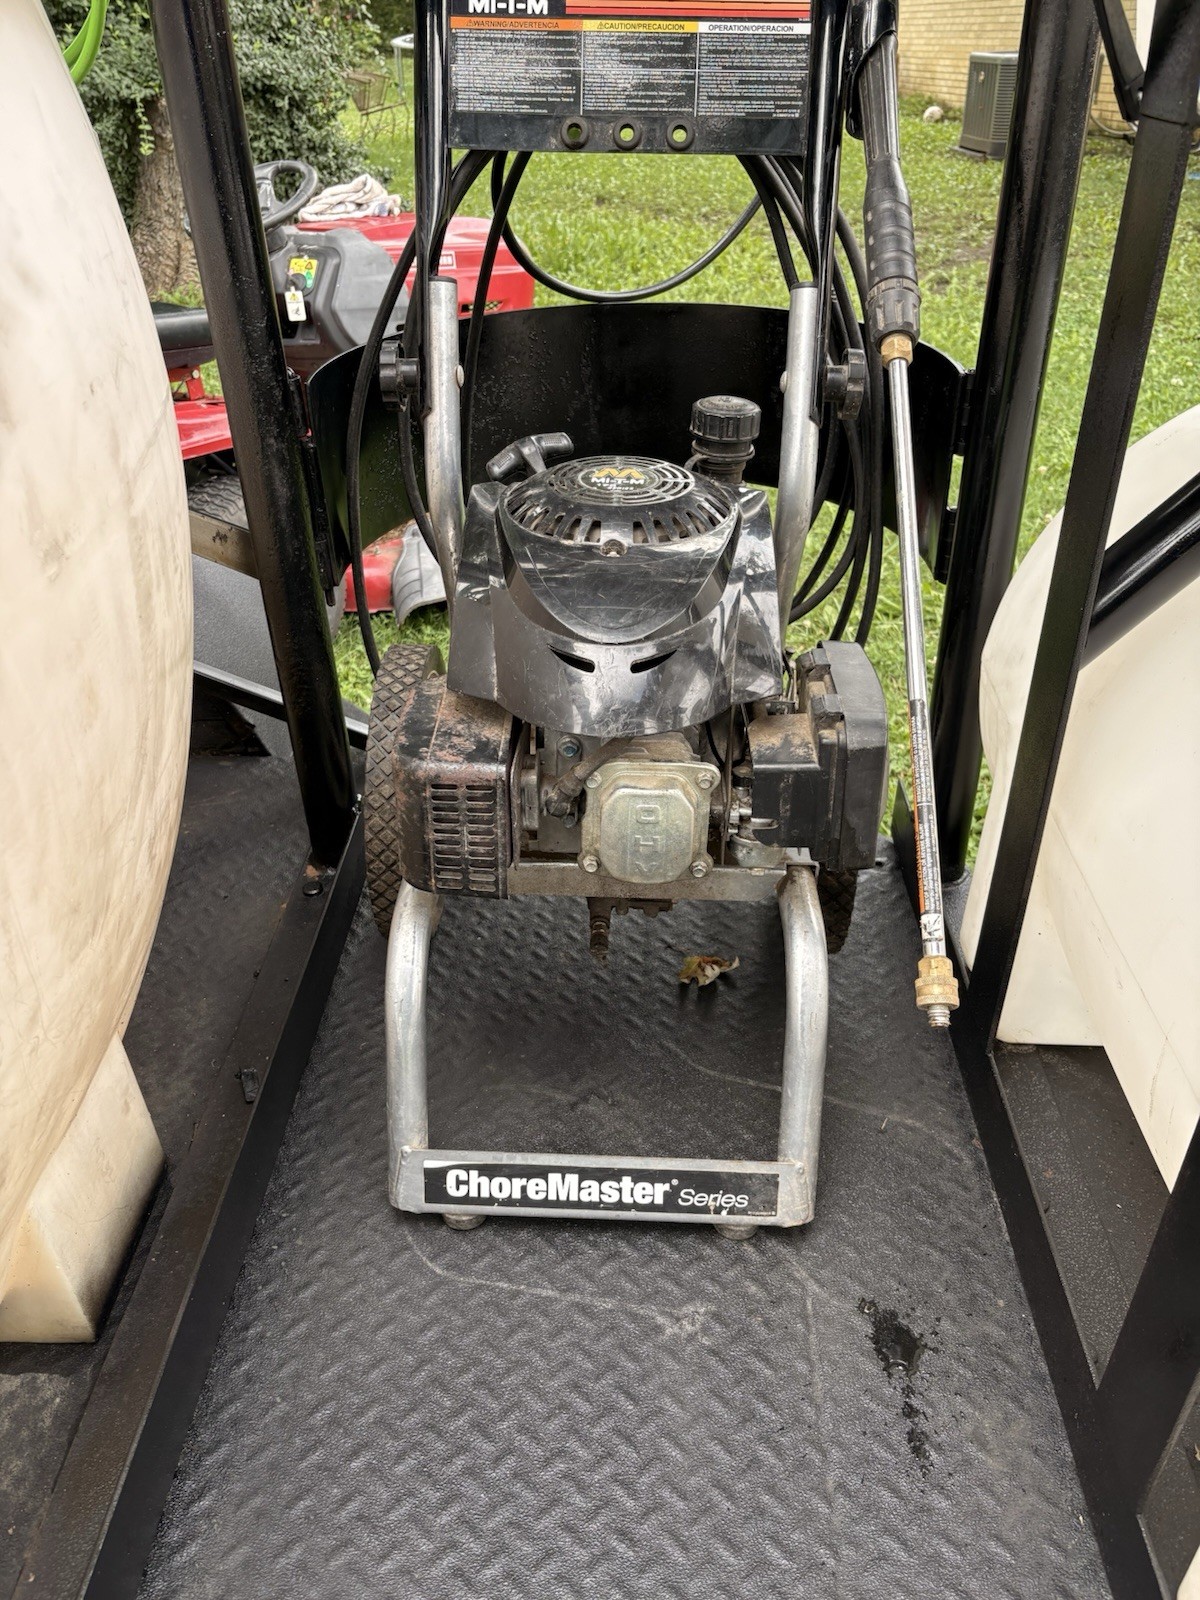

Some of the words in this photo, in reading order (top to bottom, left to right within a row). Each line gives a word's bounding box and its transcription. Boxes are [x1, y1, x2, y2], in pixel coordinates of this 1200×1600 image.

[473, 20, 559, 29] WARNING/ADVERTENCIA
[604, 22, 685, 31] CAUTION/PRECAUCION
[708, 24, 794, 32] OPERATION/OPERACION
[591, 477, 645, 485] MI-T-M
[677, 1188, 750, 1209] Series
